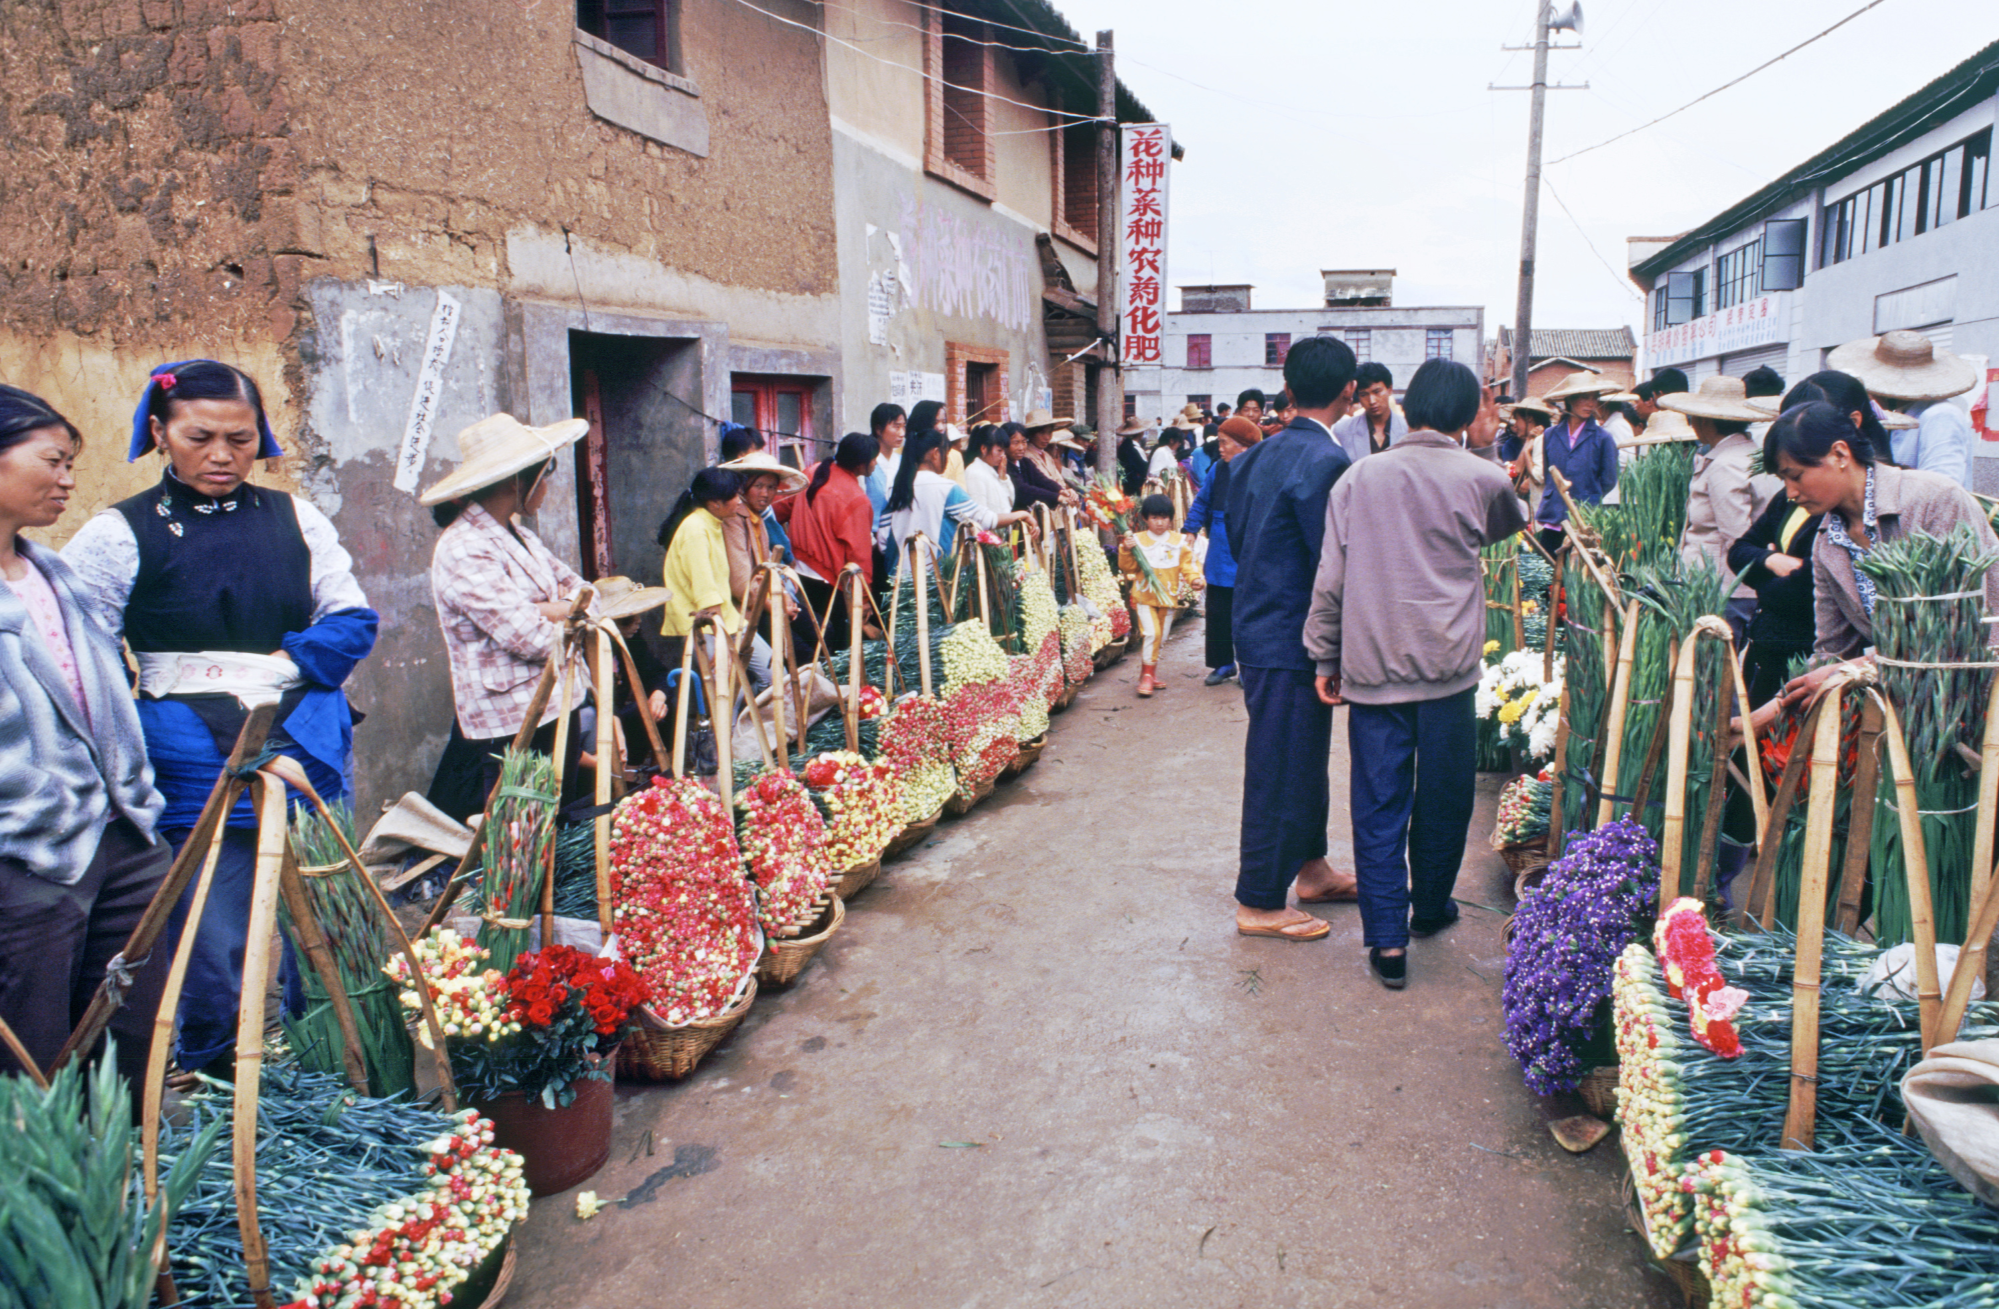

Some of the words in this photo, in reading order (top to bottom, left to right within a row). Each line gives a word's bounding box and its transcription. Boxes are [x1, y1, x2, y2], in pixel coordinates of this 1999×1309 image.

[1125, 128, 1165, 362] 花种菜种农药化肥
